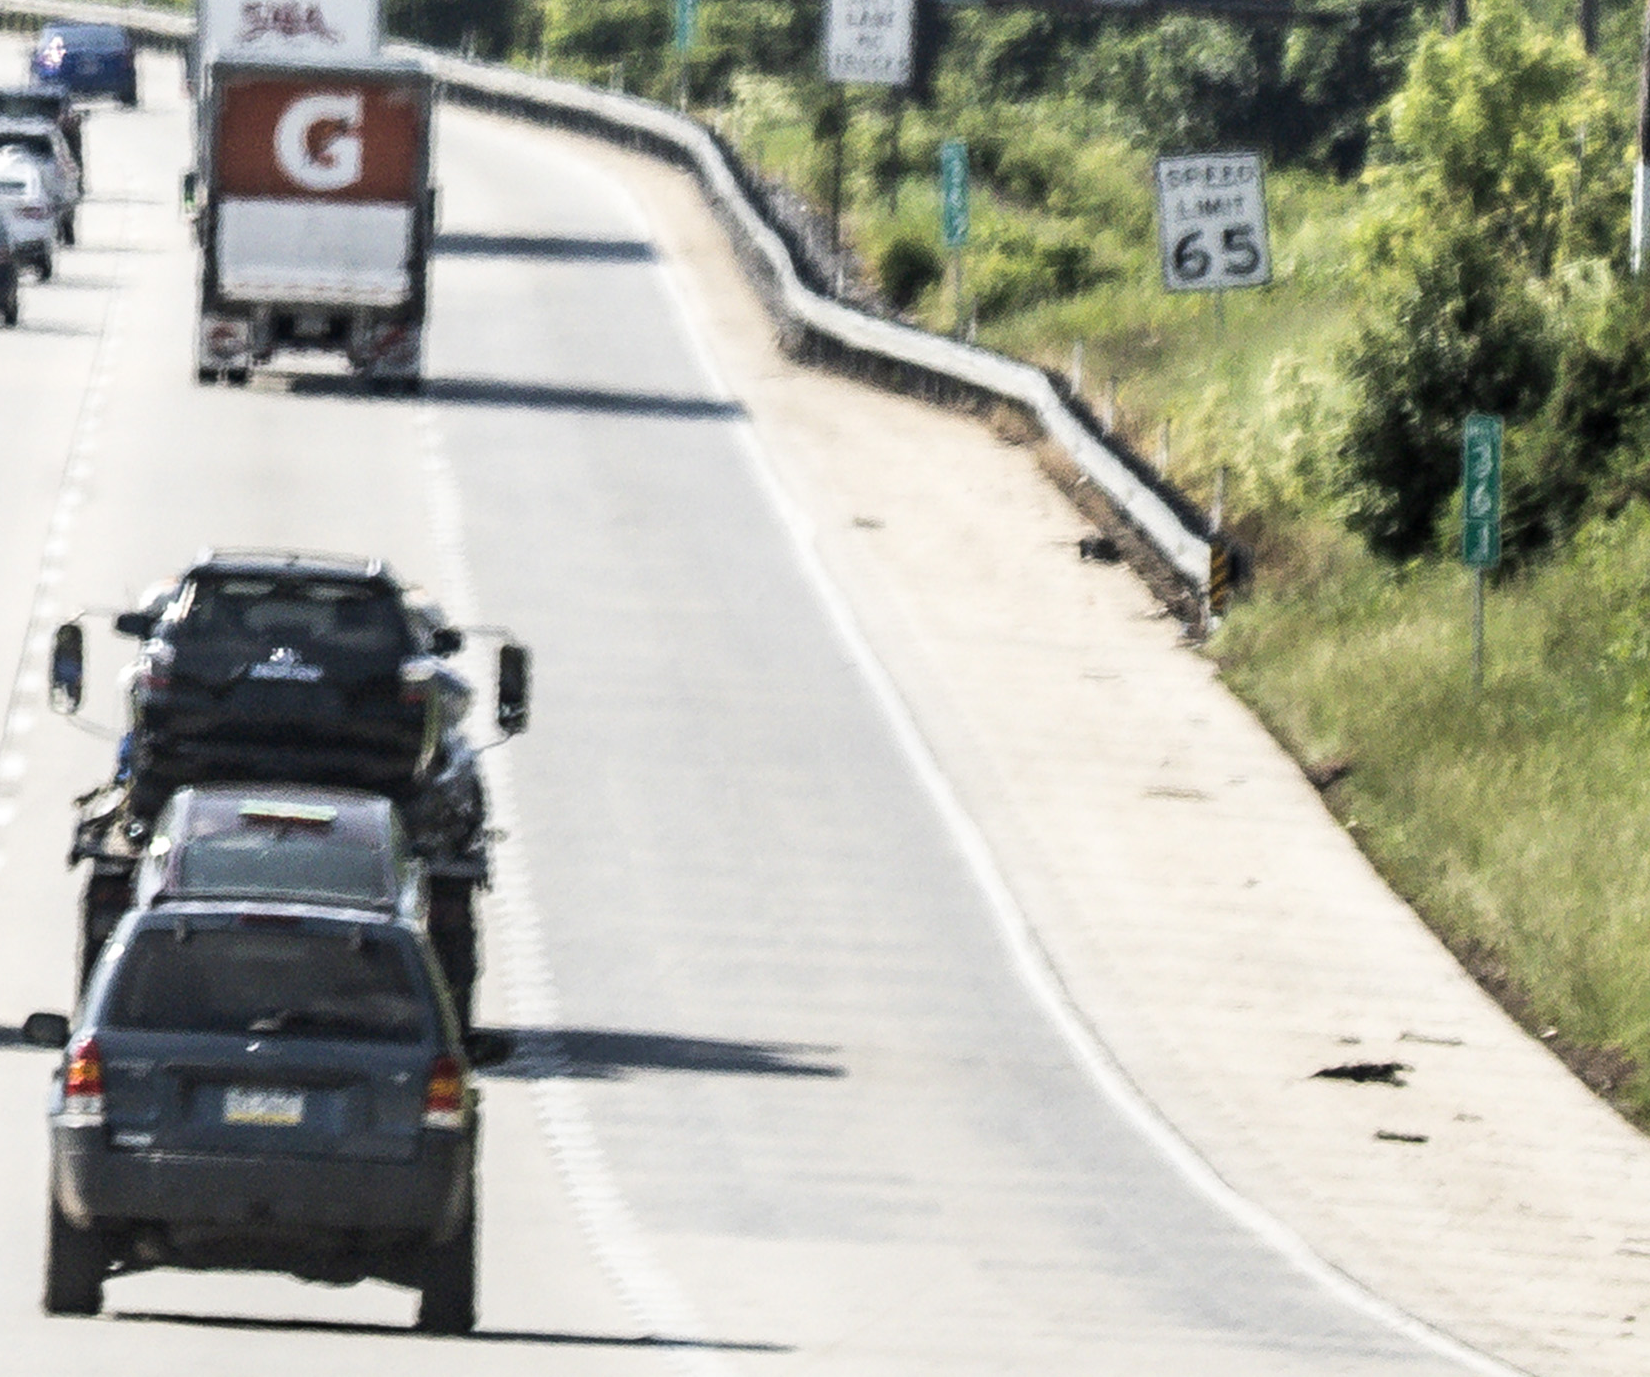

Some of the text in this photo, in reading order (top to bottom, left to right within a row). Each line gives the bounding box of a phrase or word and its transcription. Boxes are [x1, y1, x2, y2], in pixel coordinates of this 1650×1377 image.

[273, 90, 365, 192] G
[1166, 165, 1256, 190] SPEED
[1177, 195, 1245, 221] LIMIT
[1172, 223, 1261, 282] 65
